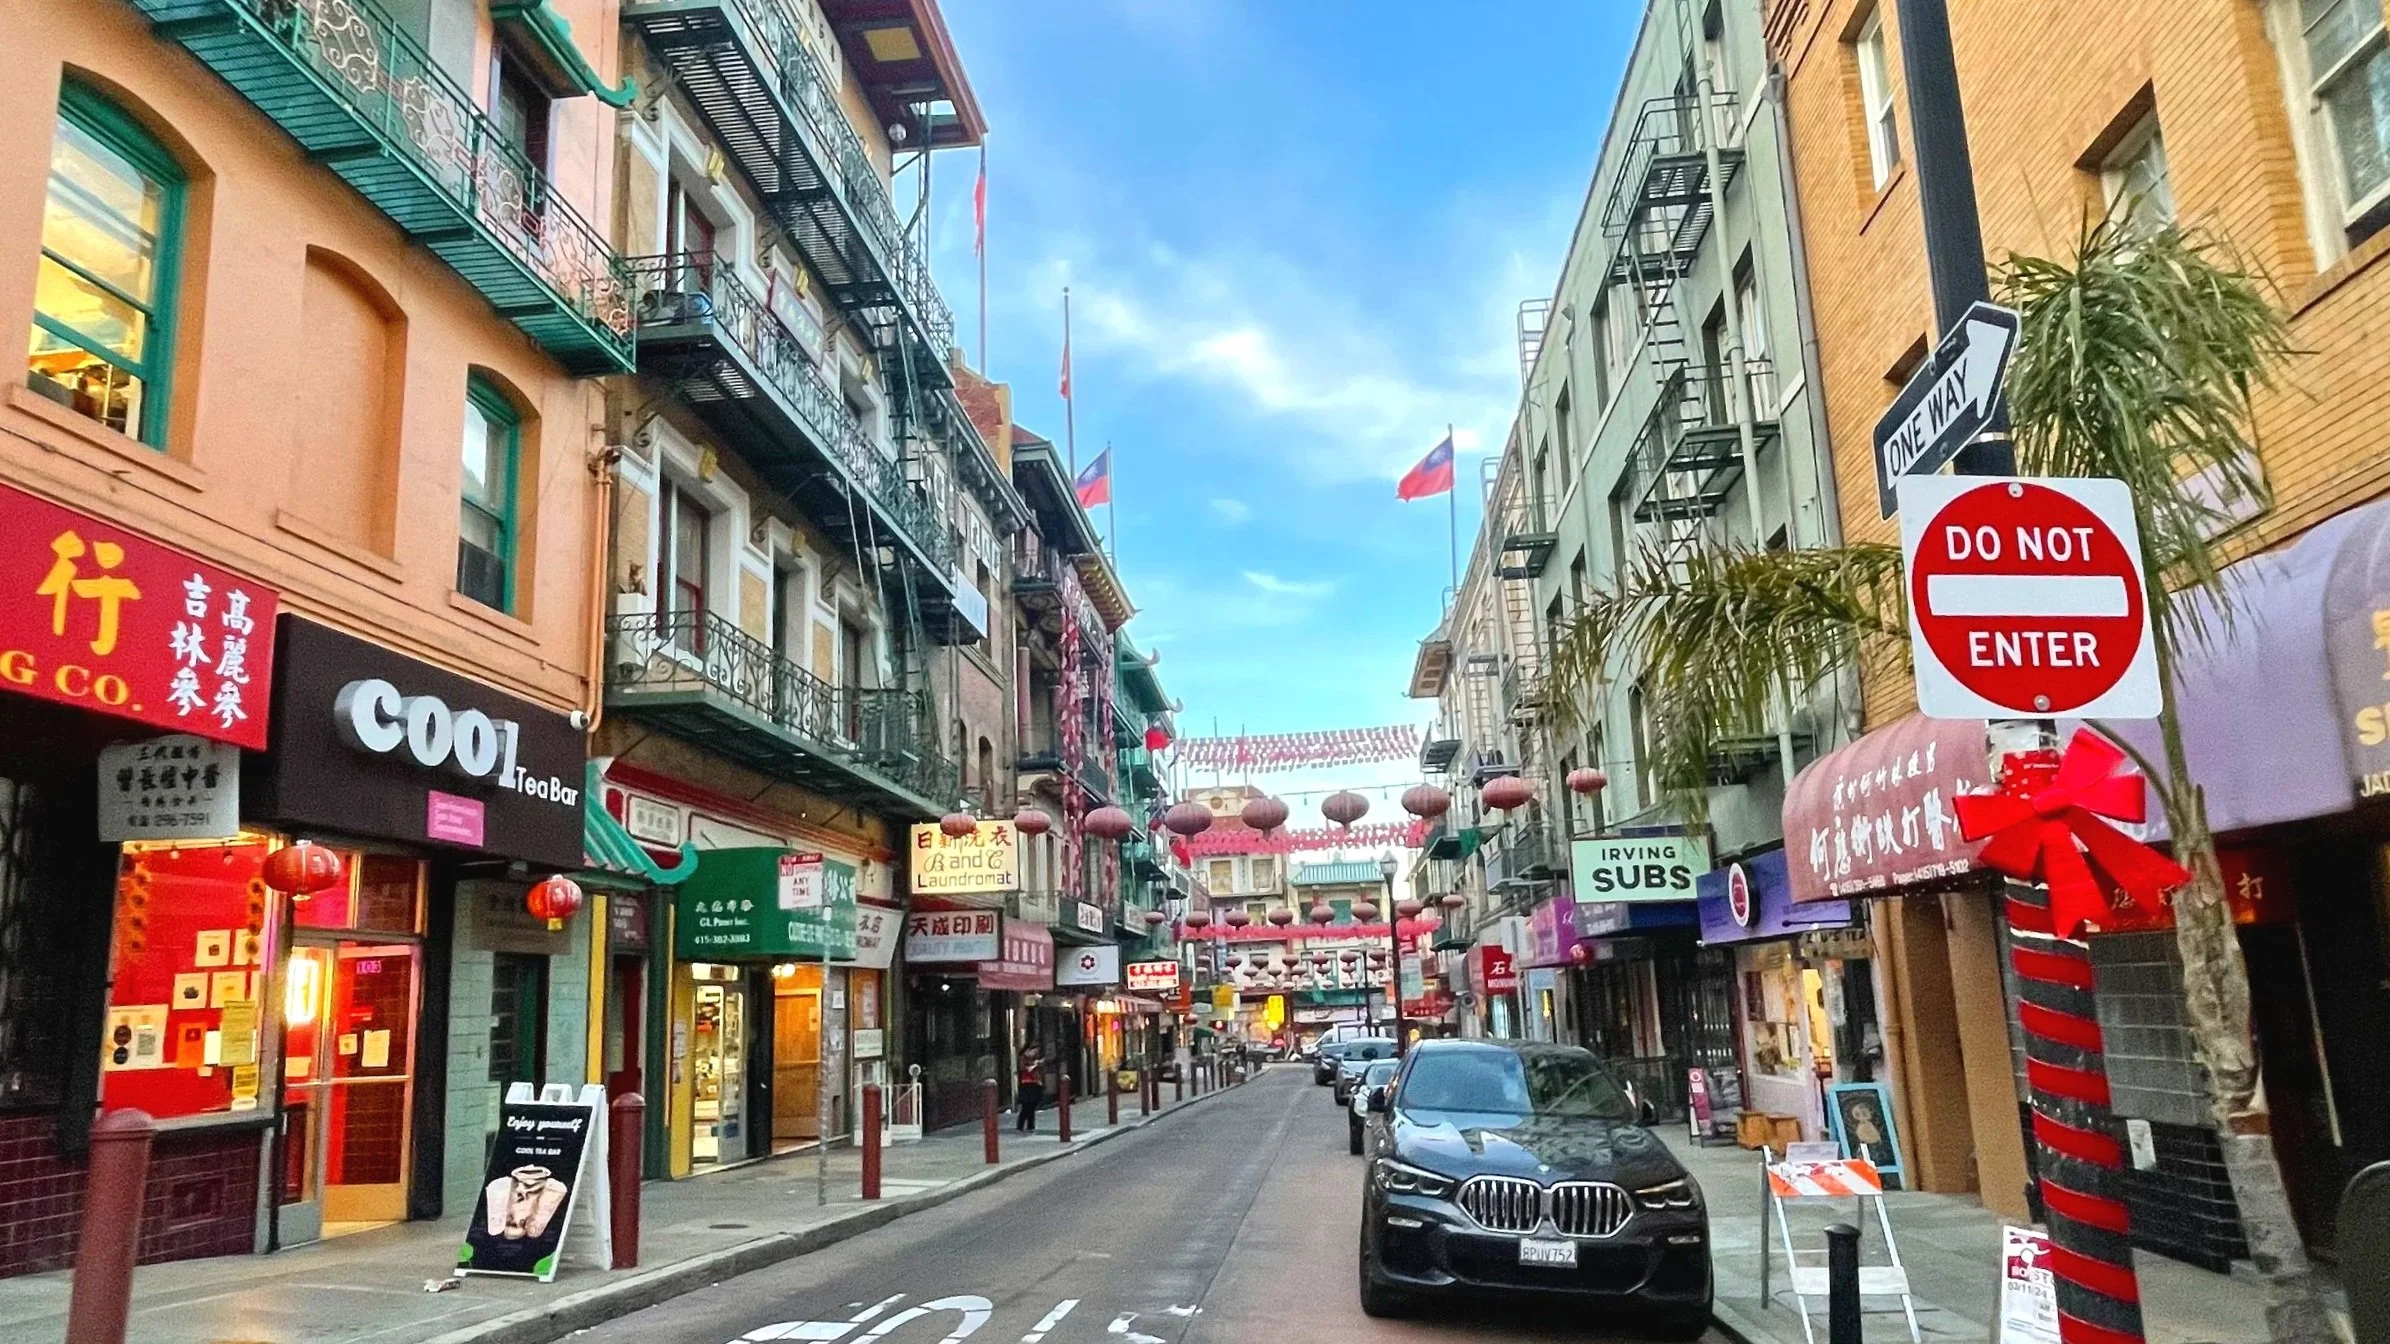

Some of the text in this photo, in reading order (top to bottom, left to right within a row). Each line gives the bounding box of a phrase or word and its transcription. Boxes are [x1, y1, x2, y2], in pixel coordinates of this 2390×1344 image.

[1889, 425, 1926, 477] ONE
[1929, 357, 1969, 433] WAY
[1945, 525, 2095, 562] DO NOT
[36, 530, 142, 656] 行
[1968, 631, 2100, 668] ENTER
[55, 665, 144, 712] CO.
[949, 850, 983, 870] and
[1601, 846, 1677, 861] IRVING
[792, 876, 810, 886] ANY
[917, 870, 1013, 889] Laundromat
[1592, 865, 1692, 893] SUBS
[792, 887, 810, 897] TIME
[908, 914, 995, 937] 天成印刷
[507, 1116, 583, 1133] Enjoy yourself
